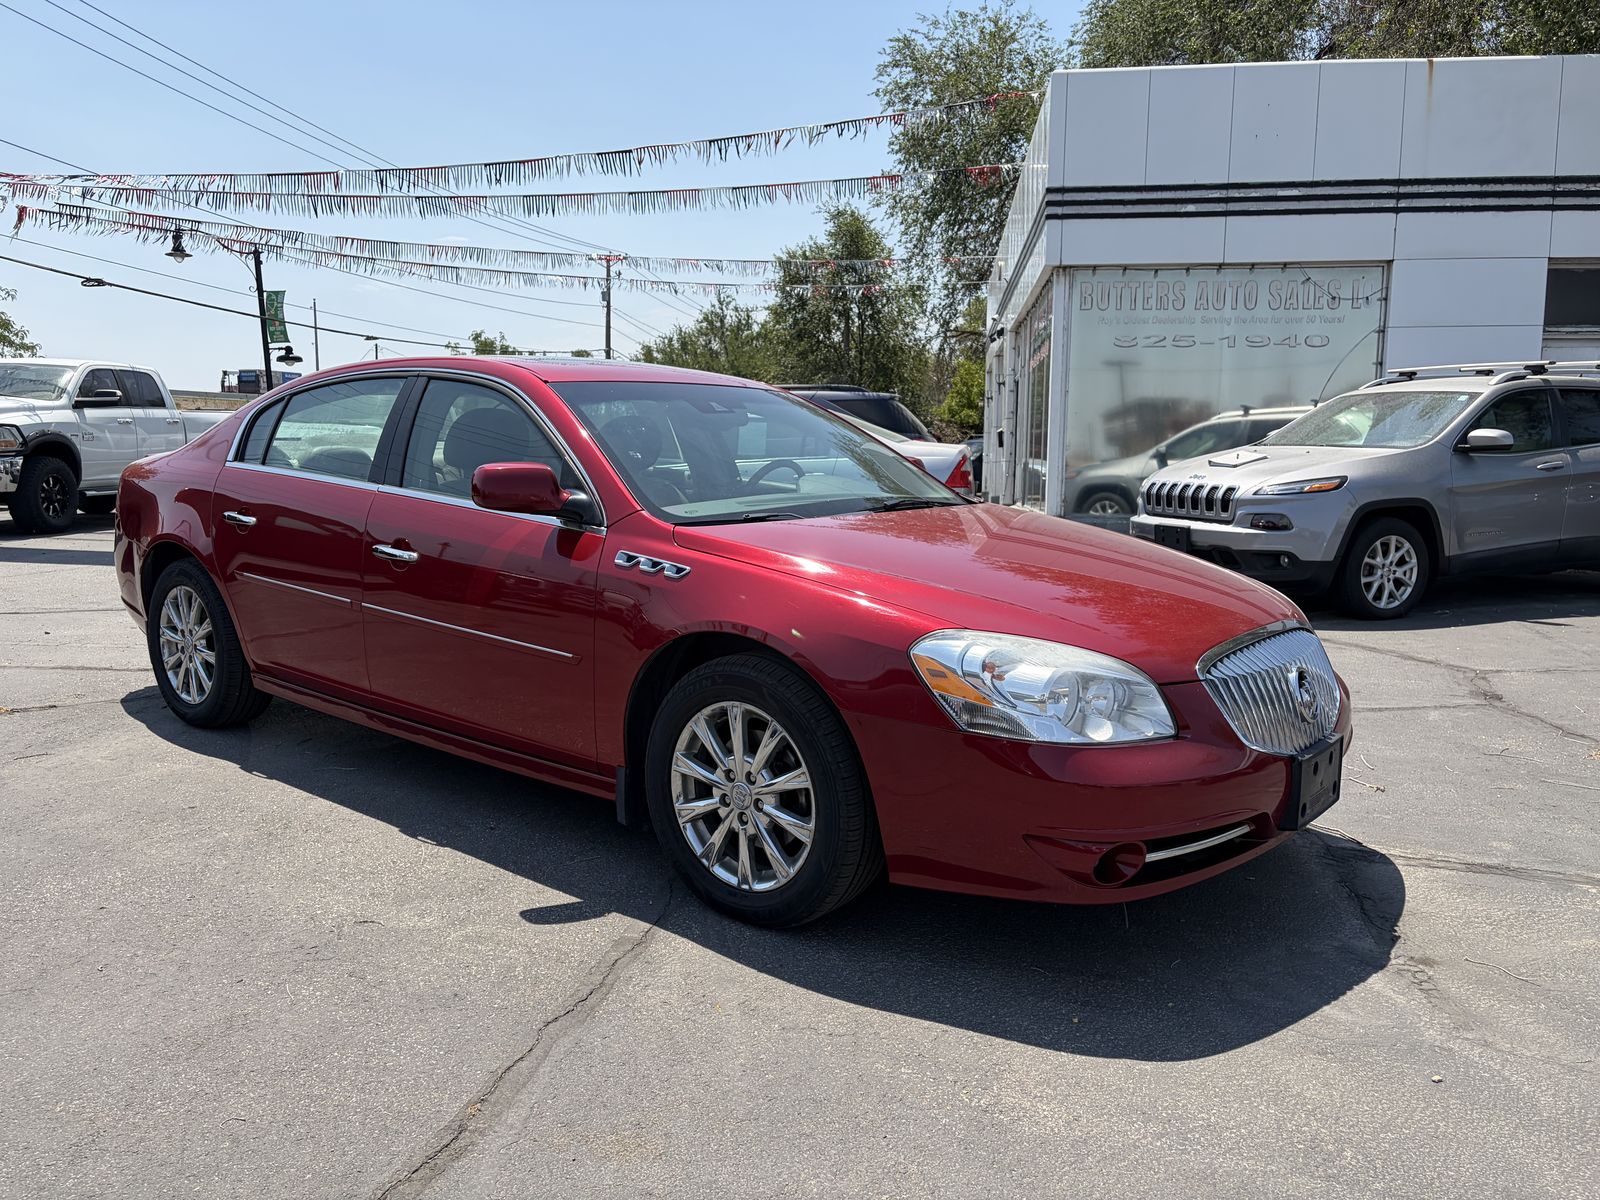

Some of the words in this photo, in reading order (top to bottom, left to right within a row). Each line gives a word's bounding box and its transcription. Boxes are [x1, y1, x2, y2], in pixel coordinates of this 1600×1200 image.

[1080, 281, 1186, 311] BUTTERS
[1195, 280, 1258, 311] AUTO
[1268, 279, 1341, 310] SALES
[1200, 315, 1232, 327] Serving
[1234, 315, 1247, 324] the
[1271, 315, 1282, 324] for
[1319, 314, 1345, 324] Years!
[1113, 334, 1330, 349] 825-1940
